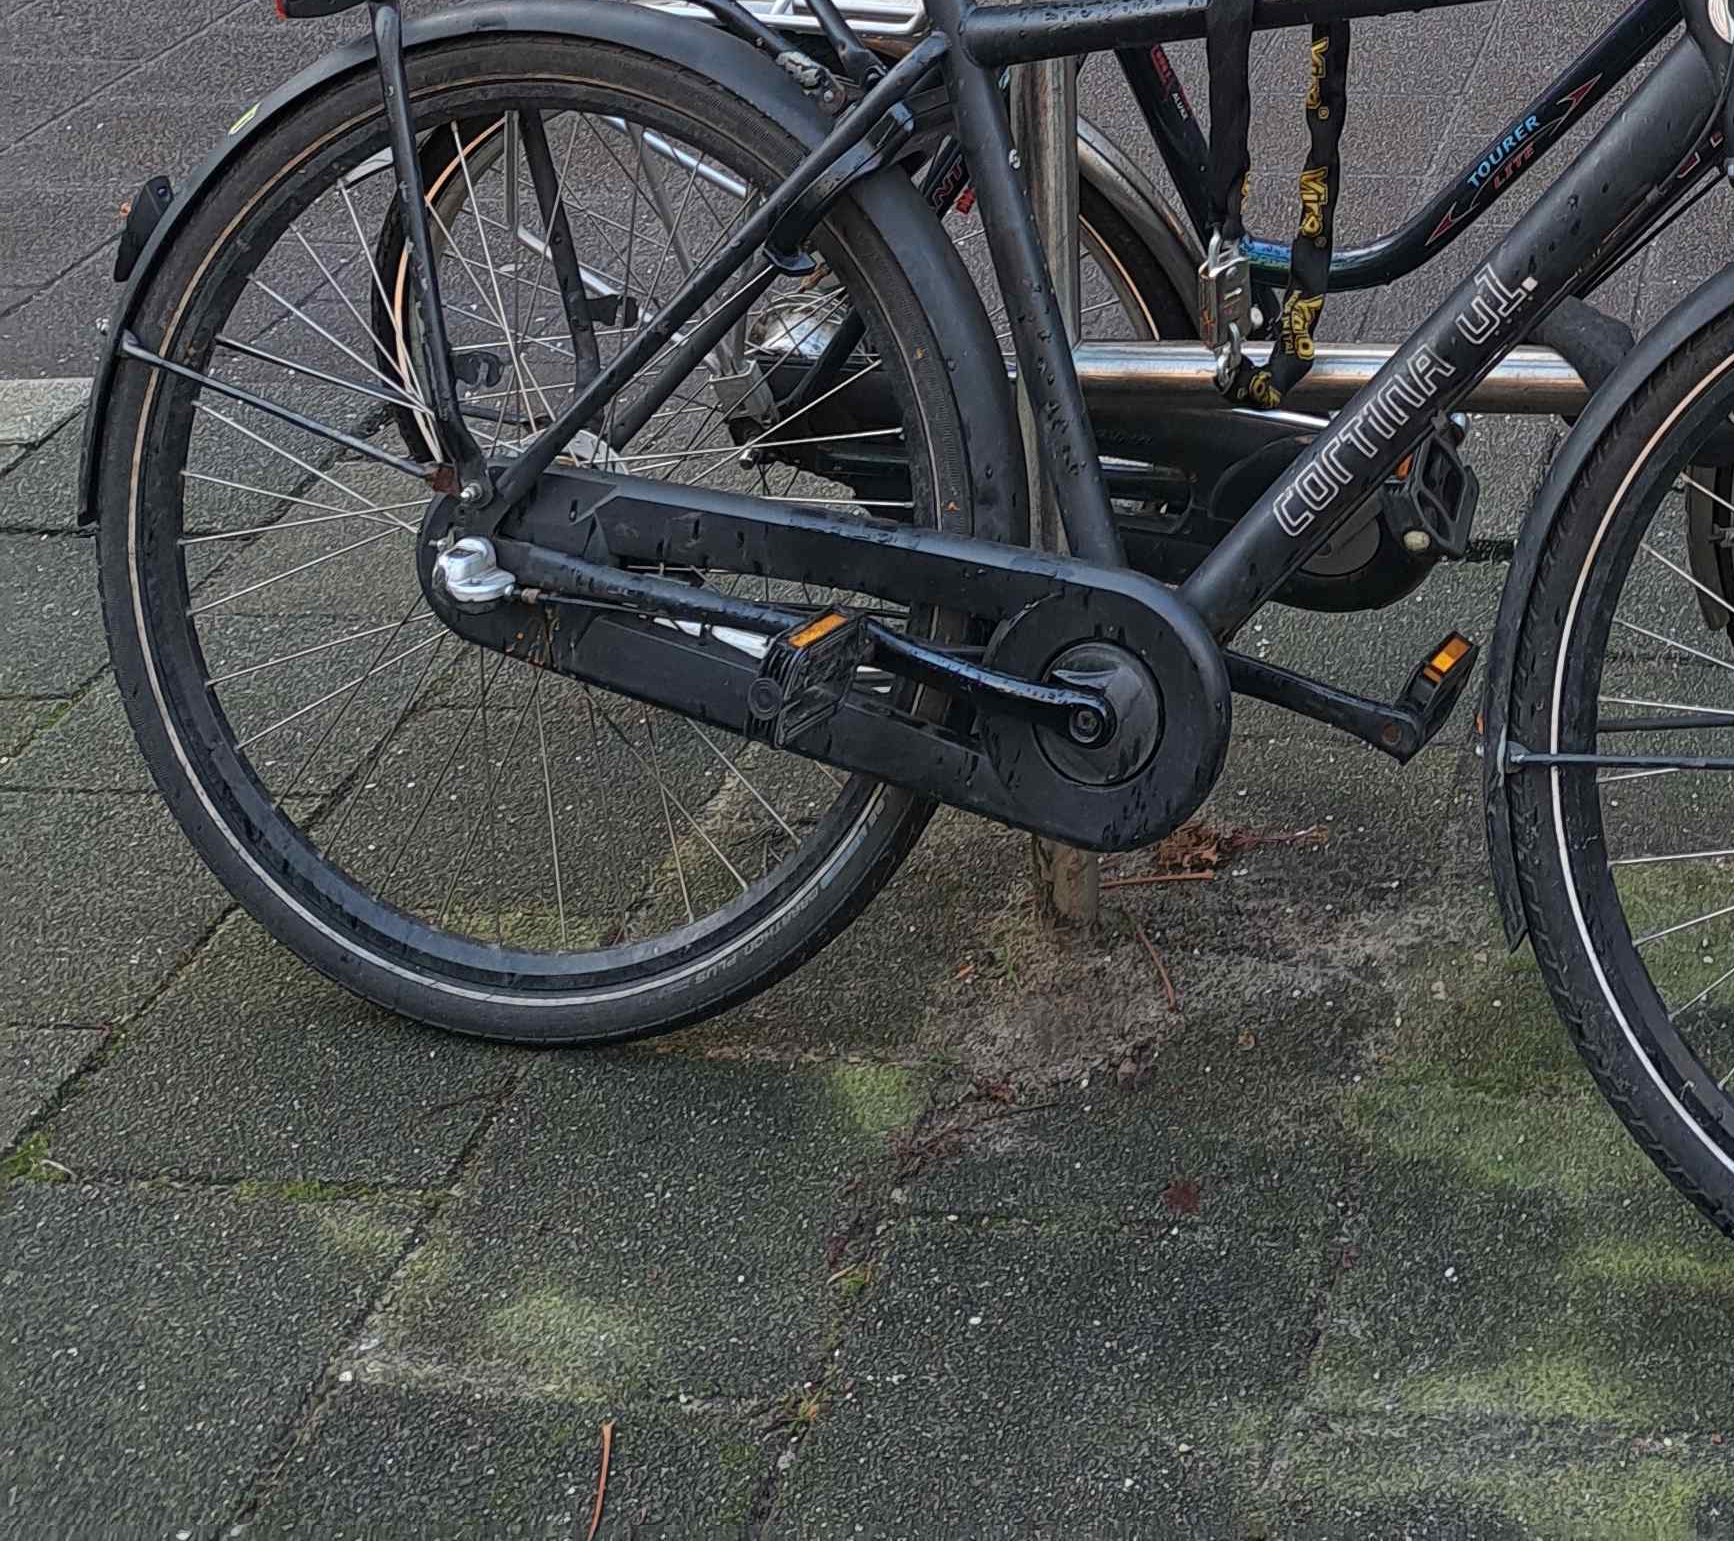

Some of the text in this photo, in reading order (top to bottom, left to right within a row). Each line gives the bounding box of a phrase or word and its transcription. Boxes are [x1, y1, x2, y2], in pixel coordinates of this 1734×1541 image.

[1466, 114, 1542, 188] TOURER
[1490, 139, 1536, 190] LITE
[694, 953, 738, 984] PLUS
